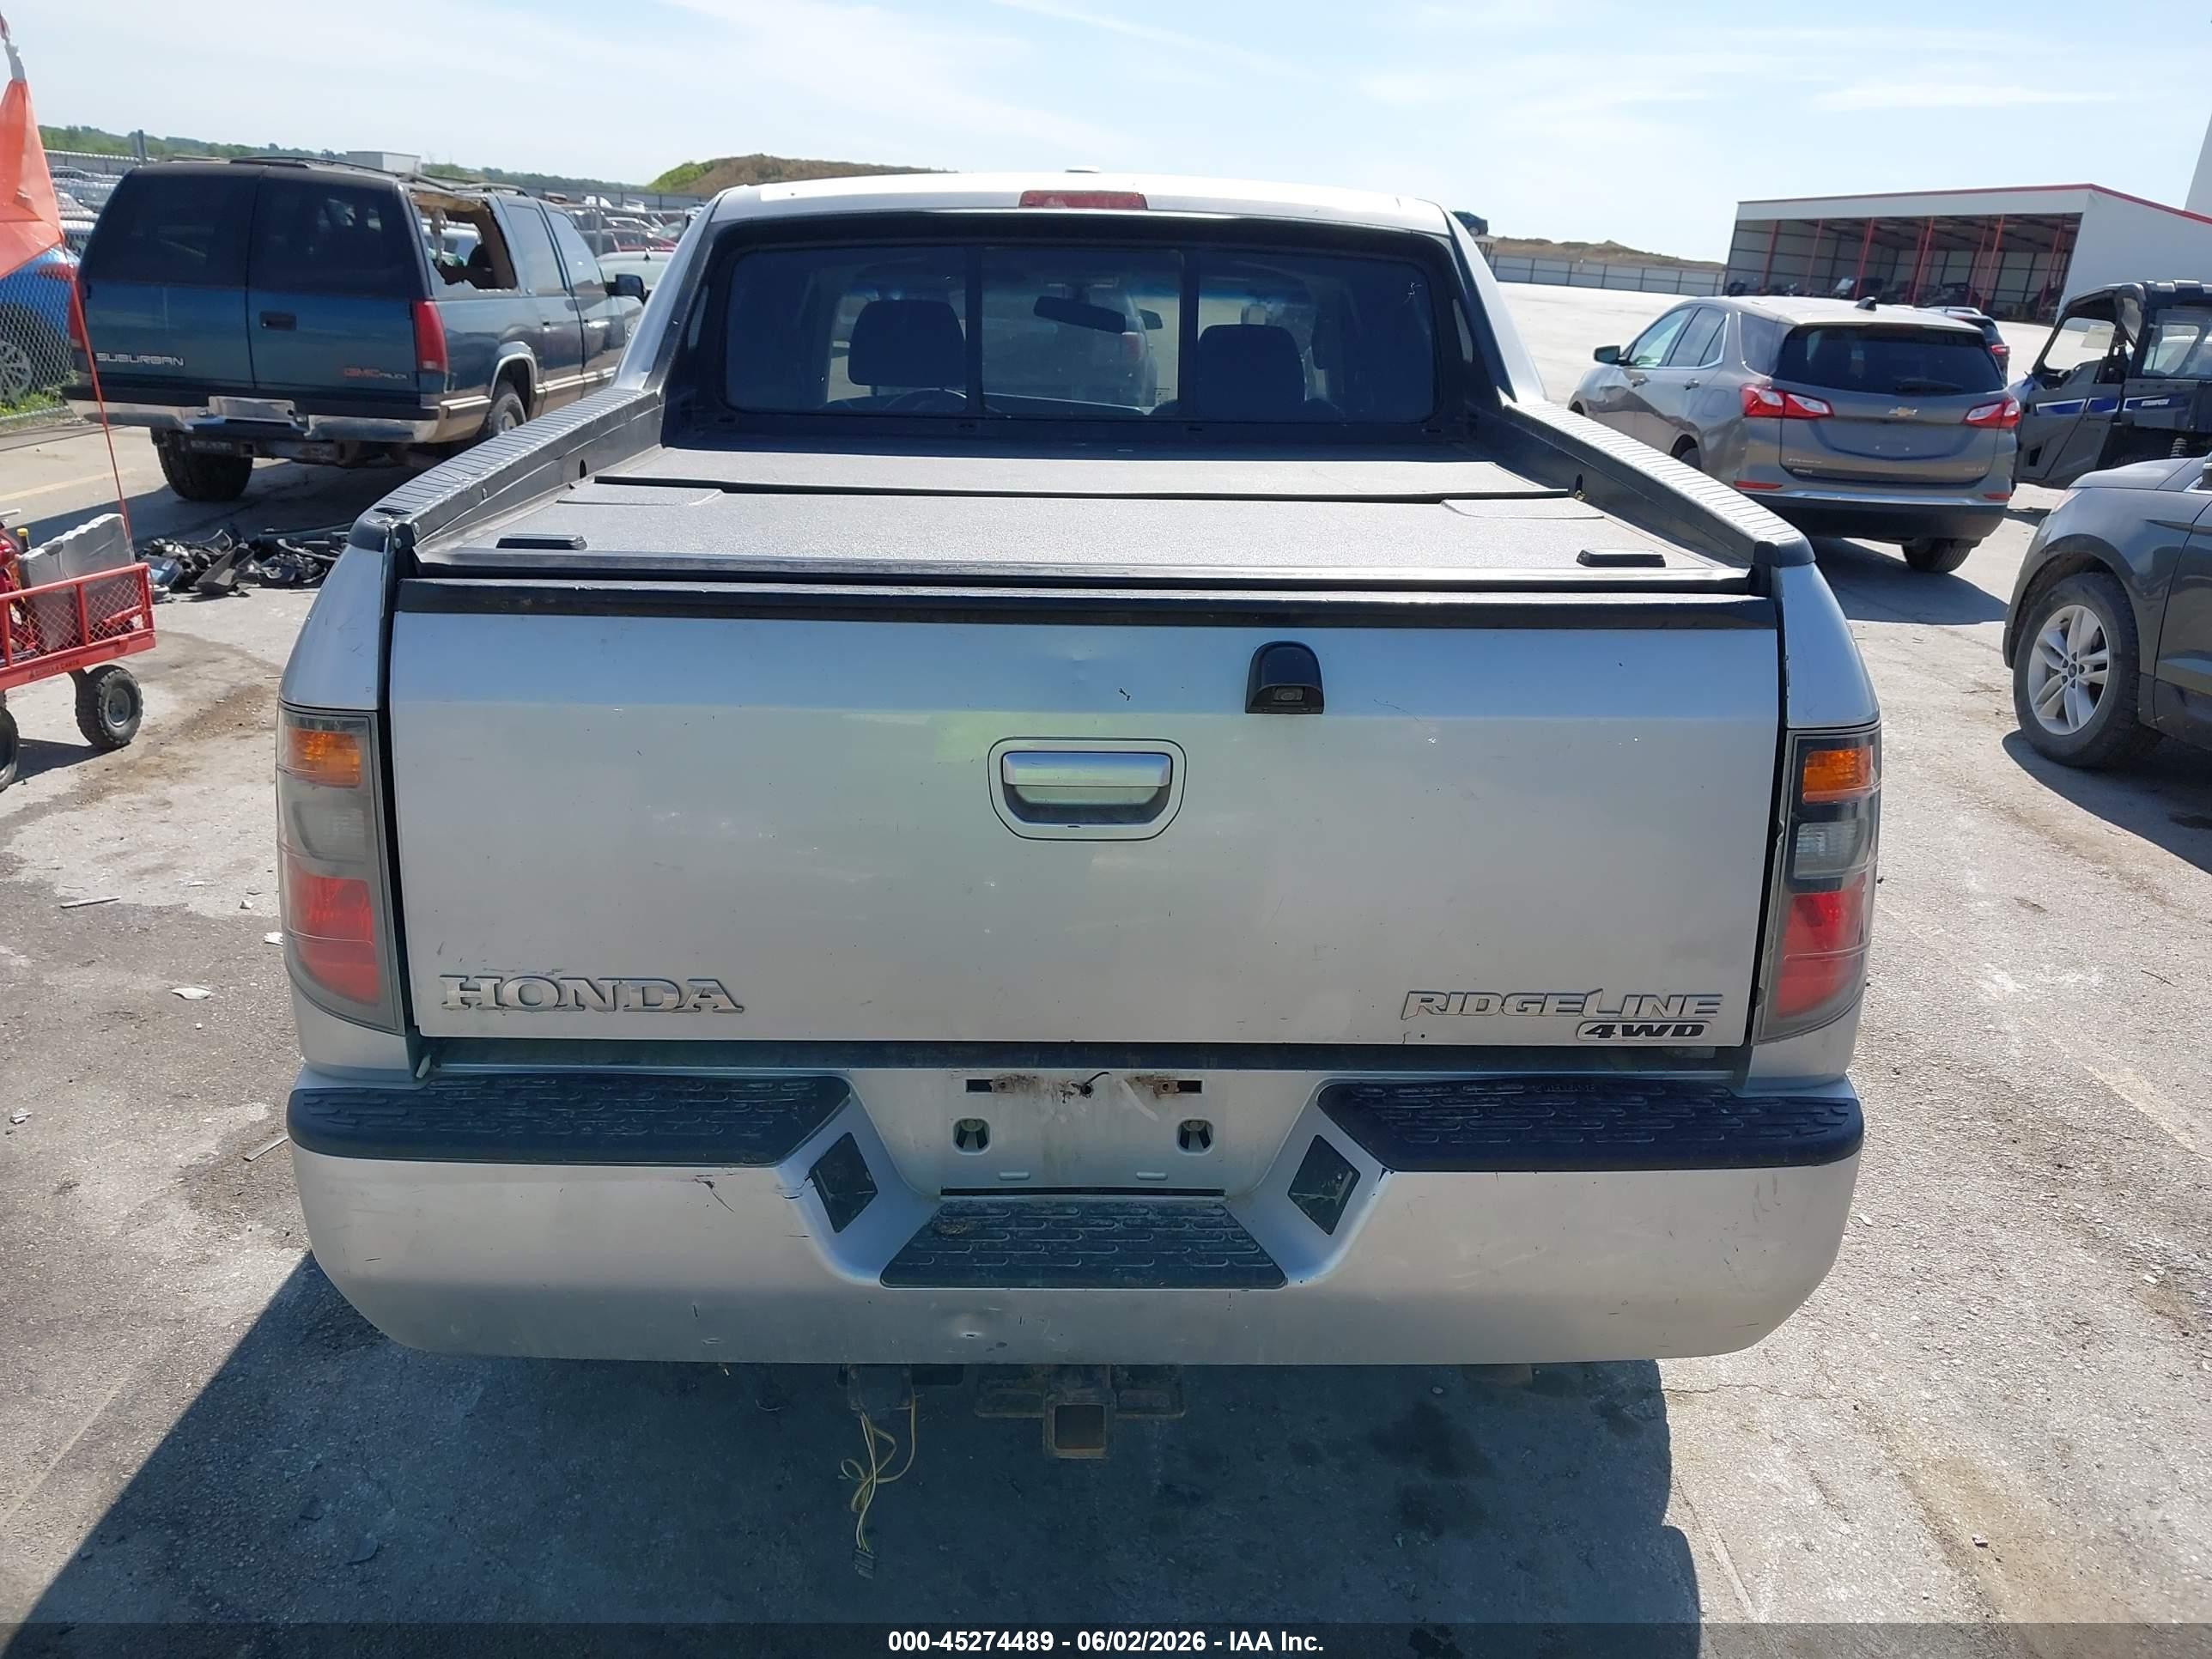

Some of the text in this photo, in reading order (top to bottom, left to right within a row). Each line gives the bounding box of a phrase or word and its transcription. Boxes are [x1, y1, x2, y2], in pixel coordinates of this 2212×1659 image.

[95, 352, 185, 367] SUBURBAN
[439, 975, 744, 1013] HONDA
[1401, 988, 1723, 1020] RIDGELINE
[1584, 1024, 1705, 1039] 4WD
